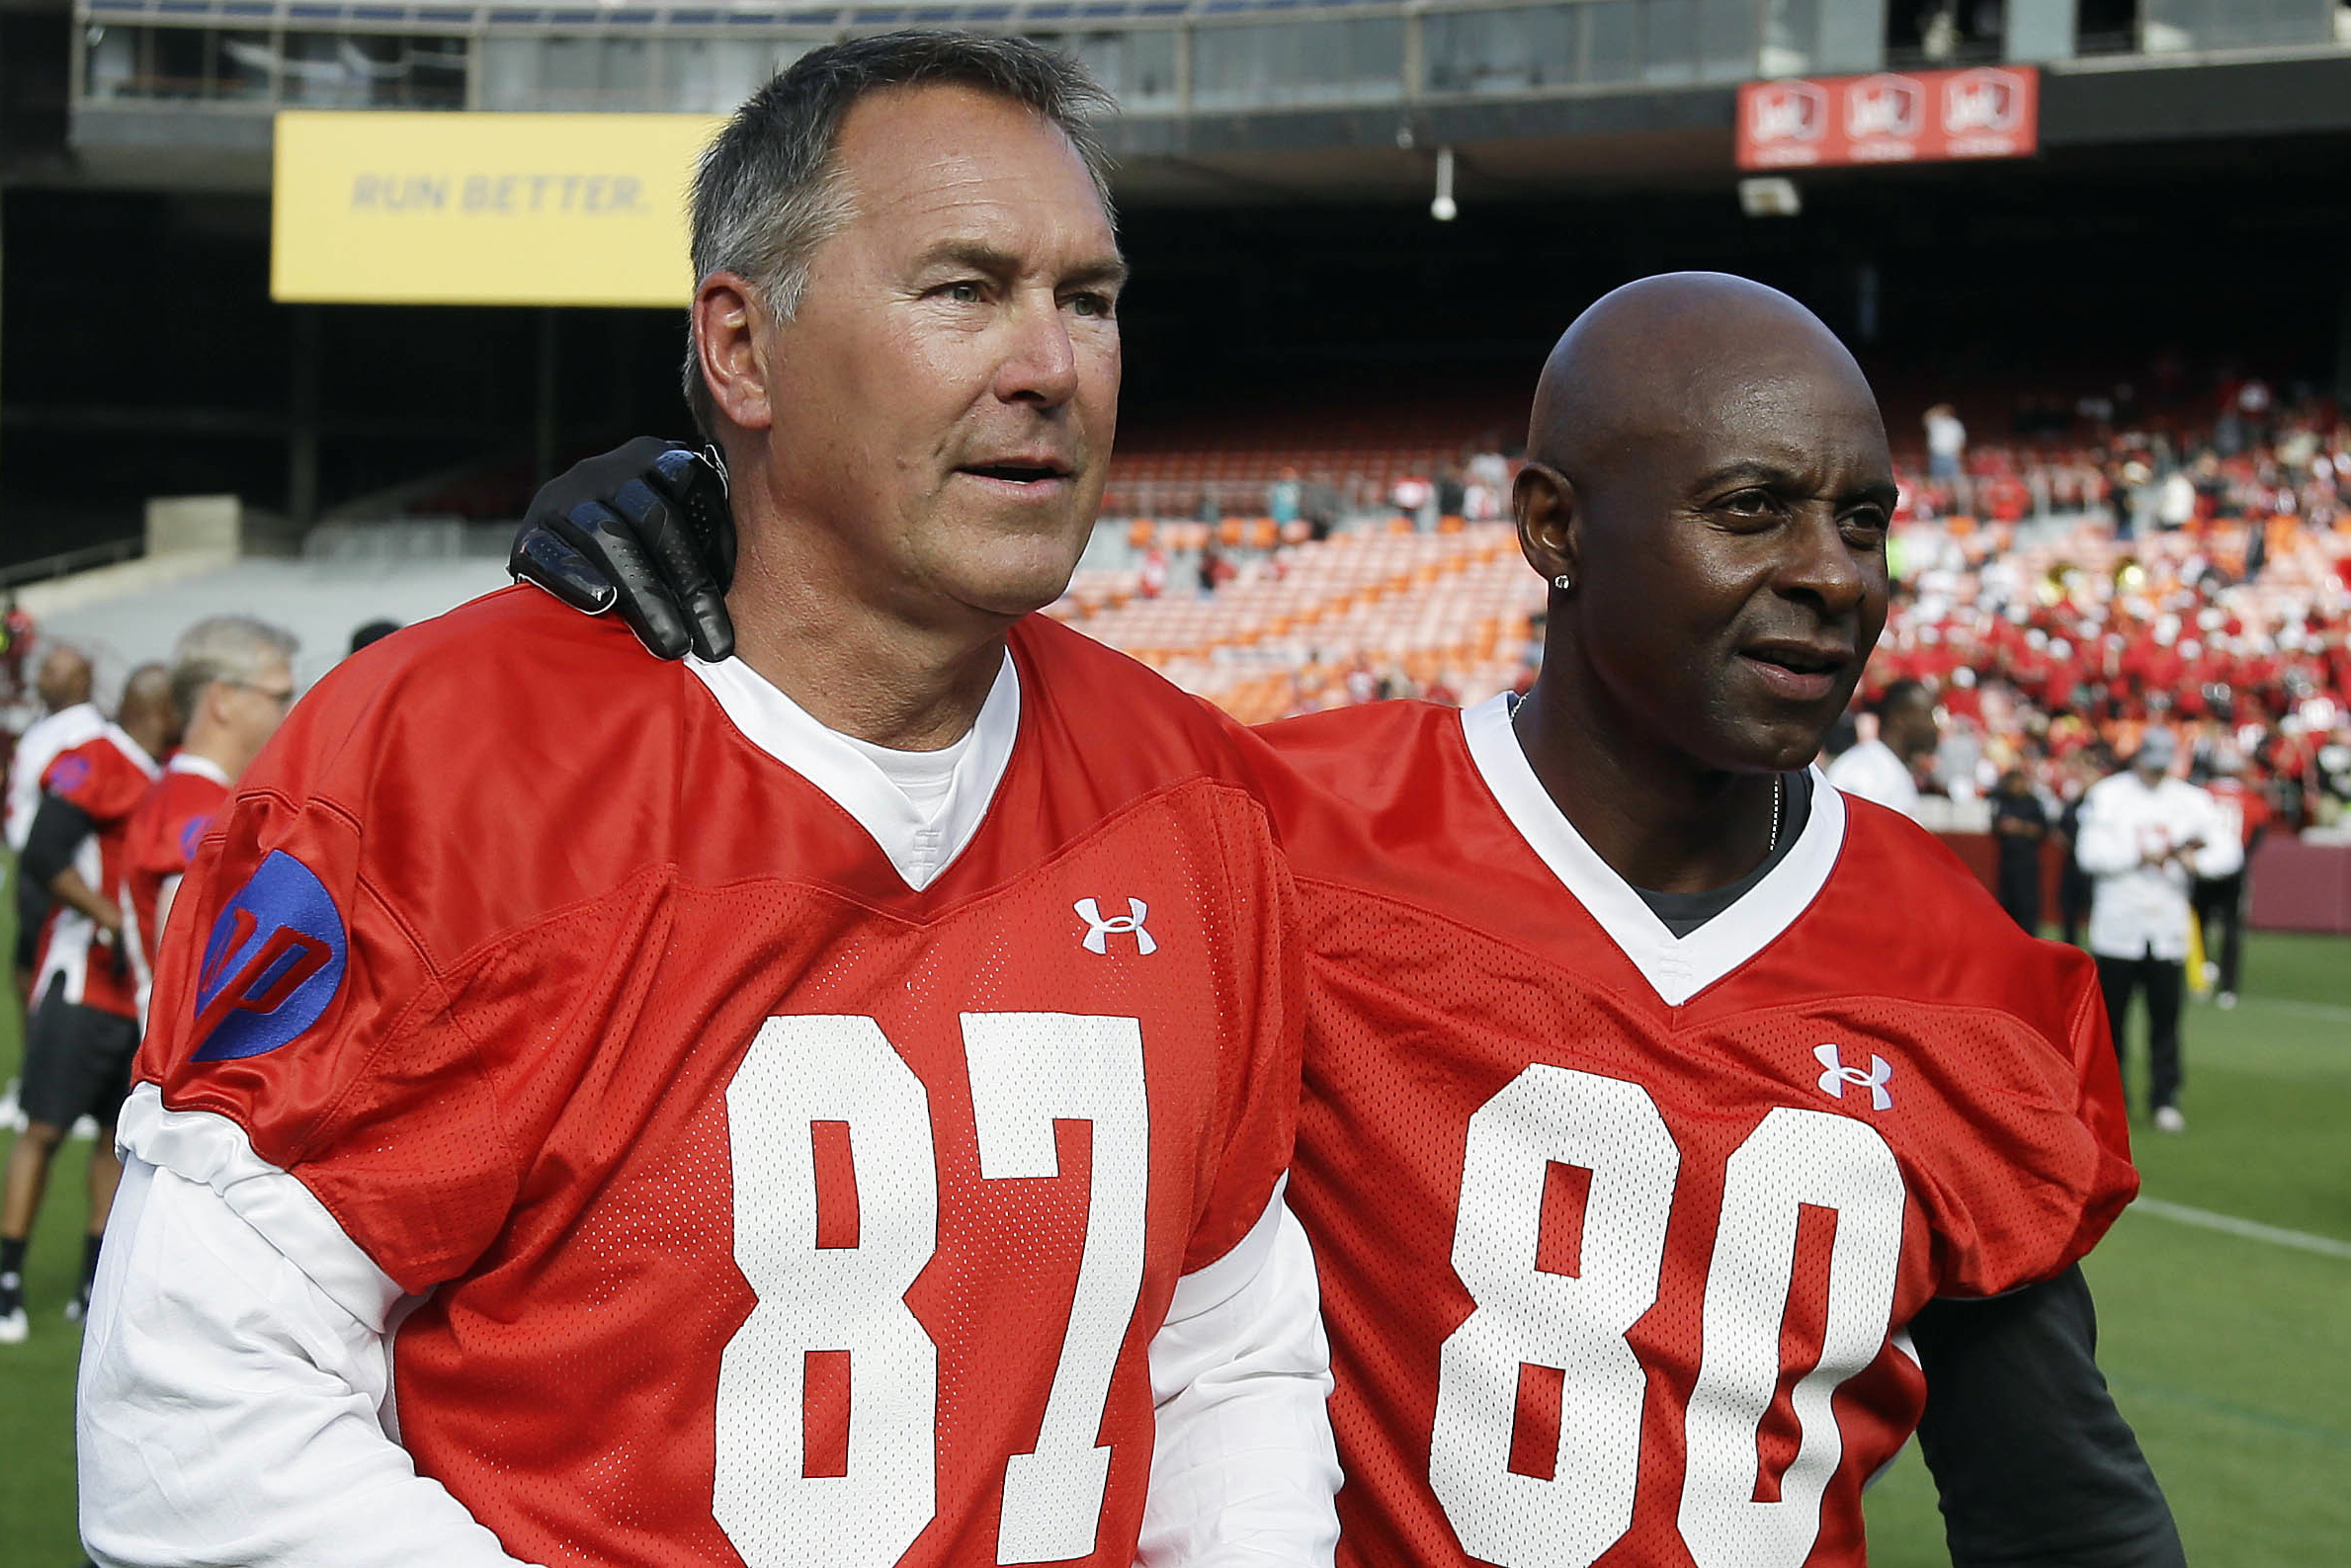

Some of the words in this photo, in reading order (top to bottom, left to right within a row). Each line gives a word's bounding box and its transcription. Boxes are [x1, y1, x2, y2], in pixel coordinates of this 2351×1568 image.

[351, 174, 447, 213] RUN
[711, 1011, 1150, 1568] 87
[1428, 1061, 1907, 1568] 80
